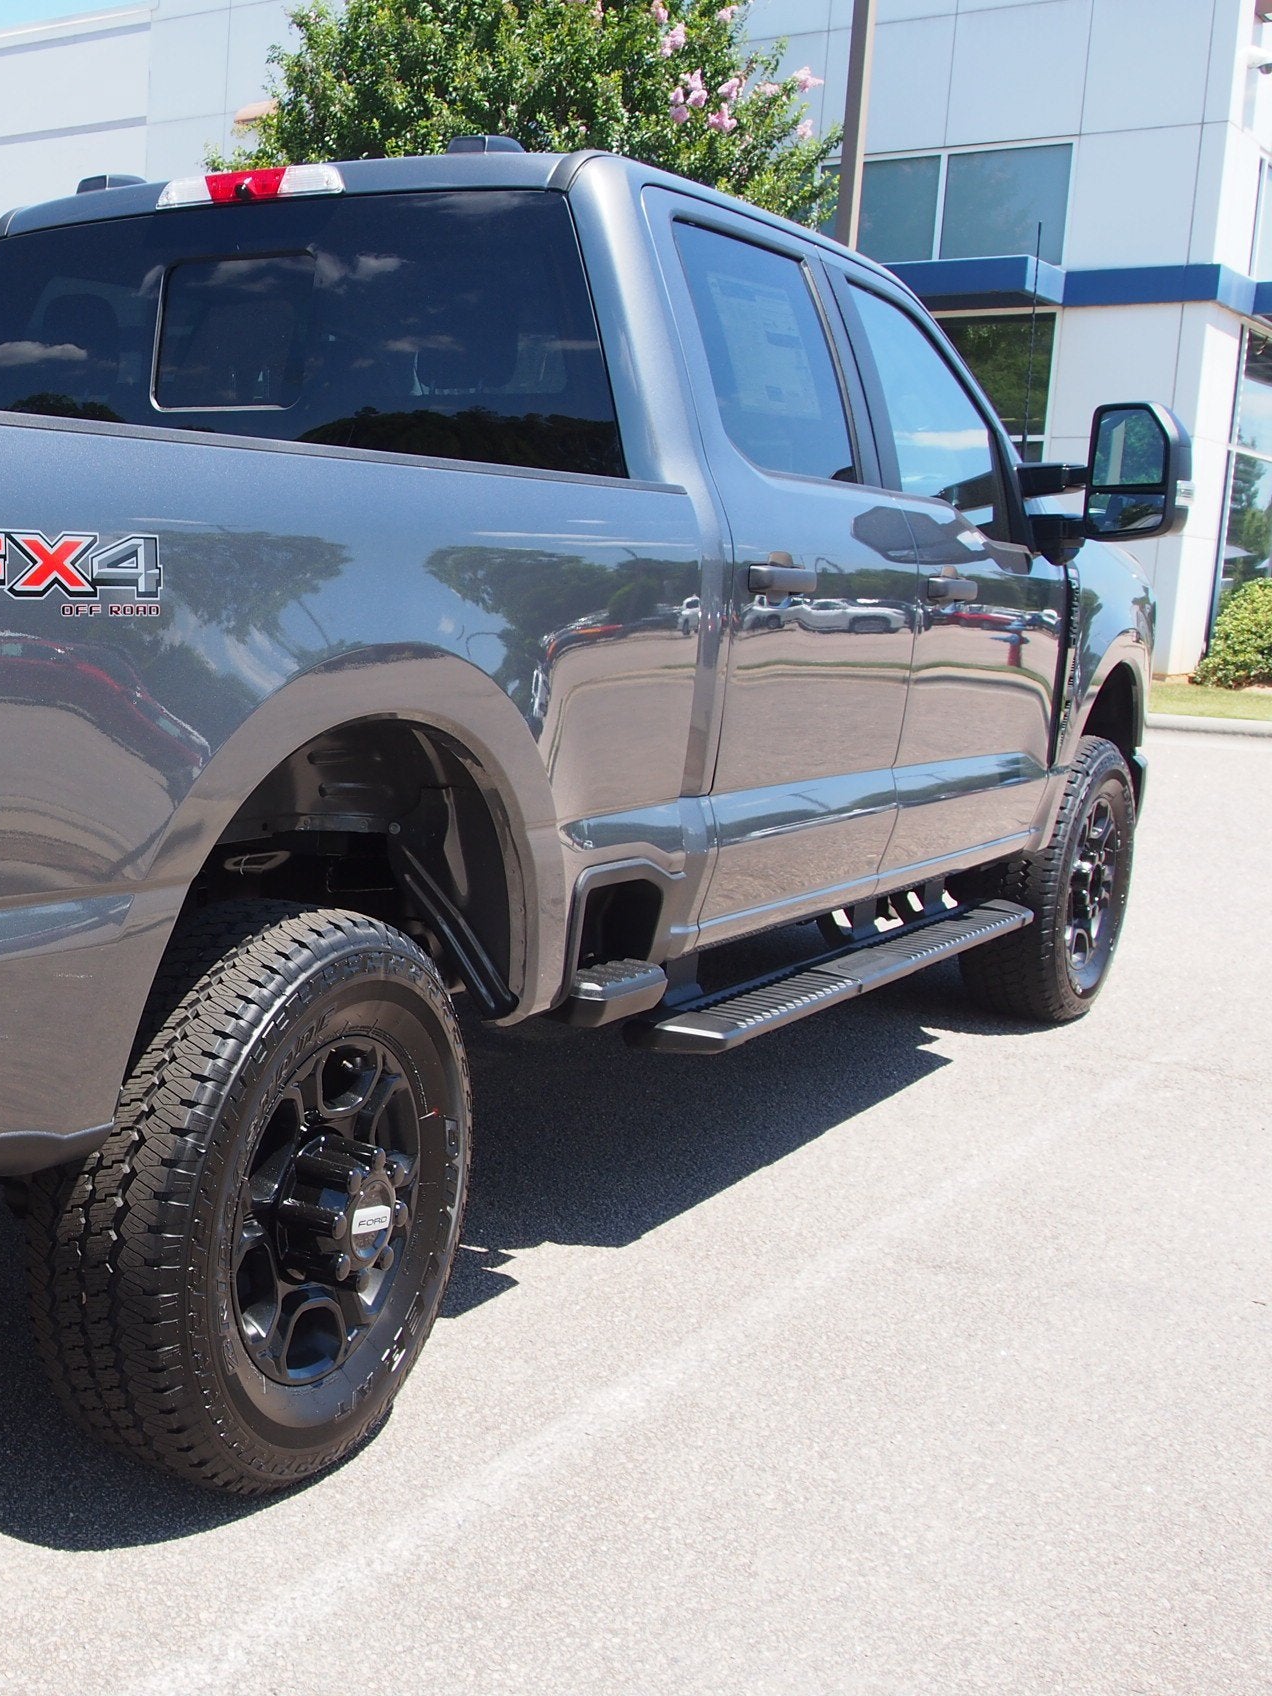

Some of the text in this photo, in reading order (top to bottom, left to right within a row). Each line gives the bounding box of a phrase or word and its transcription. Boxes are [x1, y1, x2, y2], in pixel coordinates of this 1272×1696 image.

[61, 604, 161, 617] OFF ROAD
[357, 1215, 388, 1228] FORD
